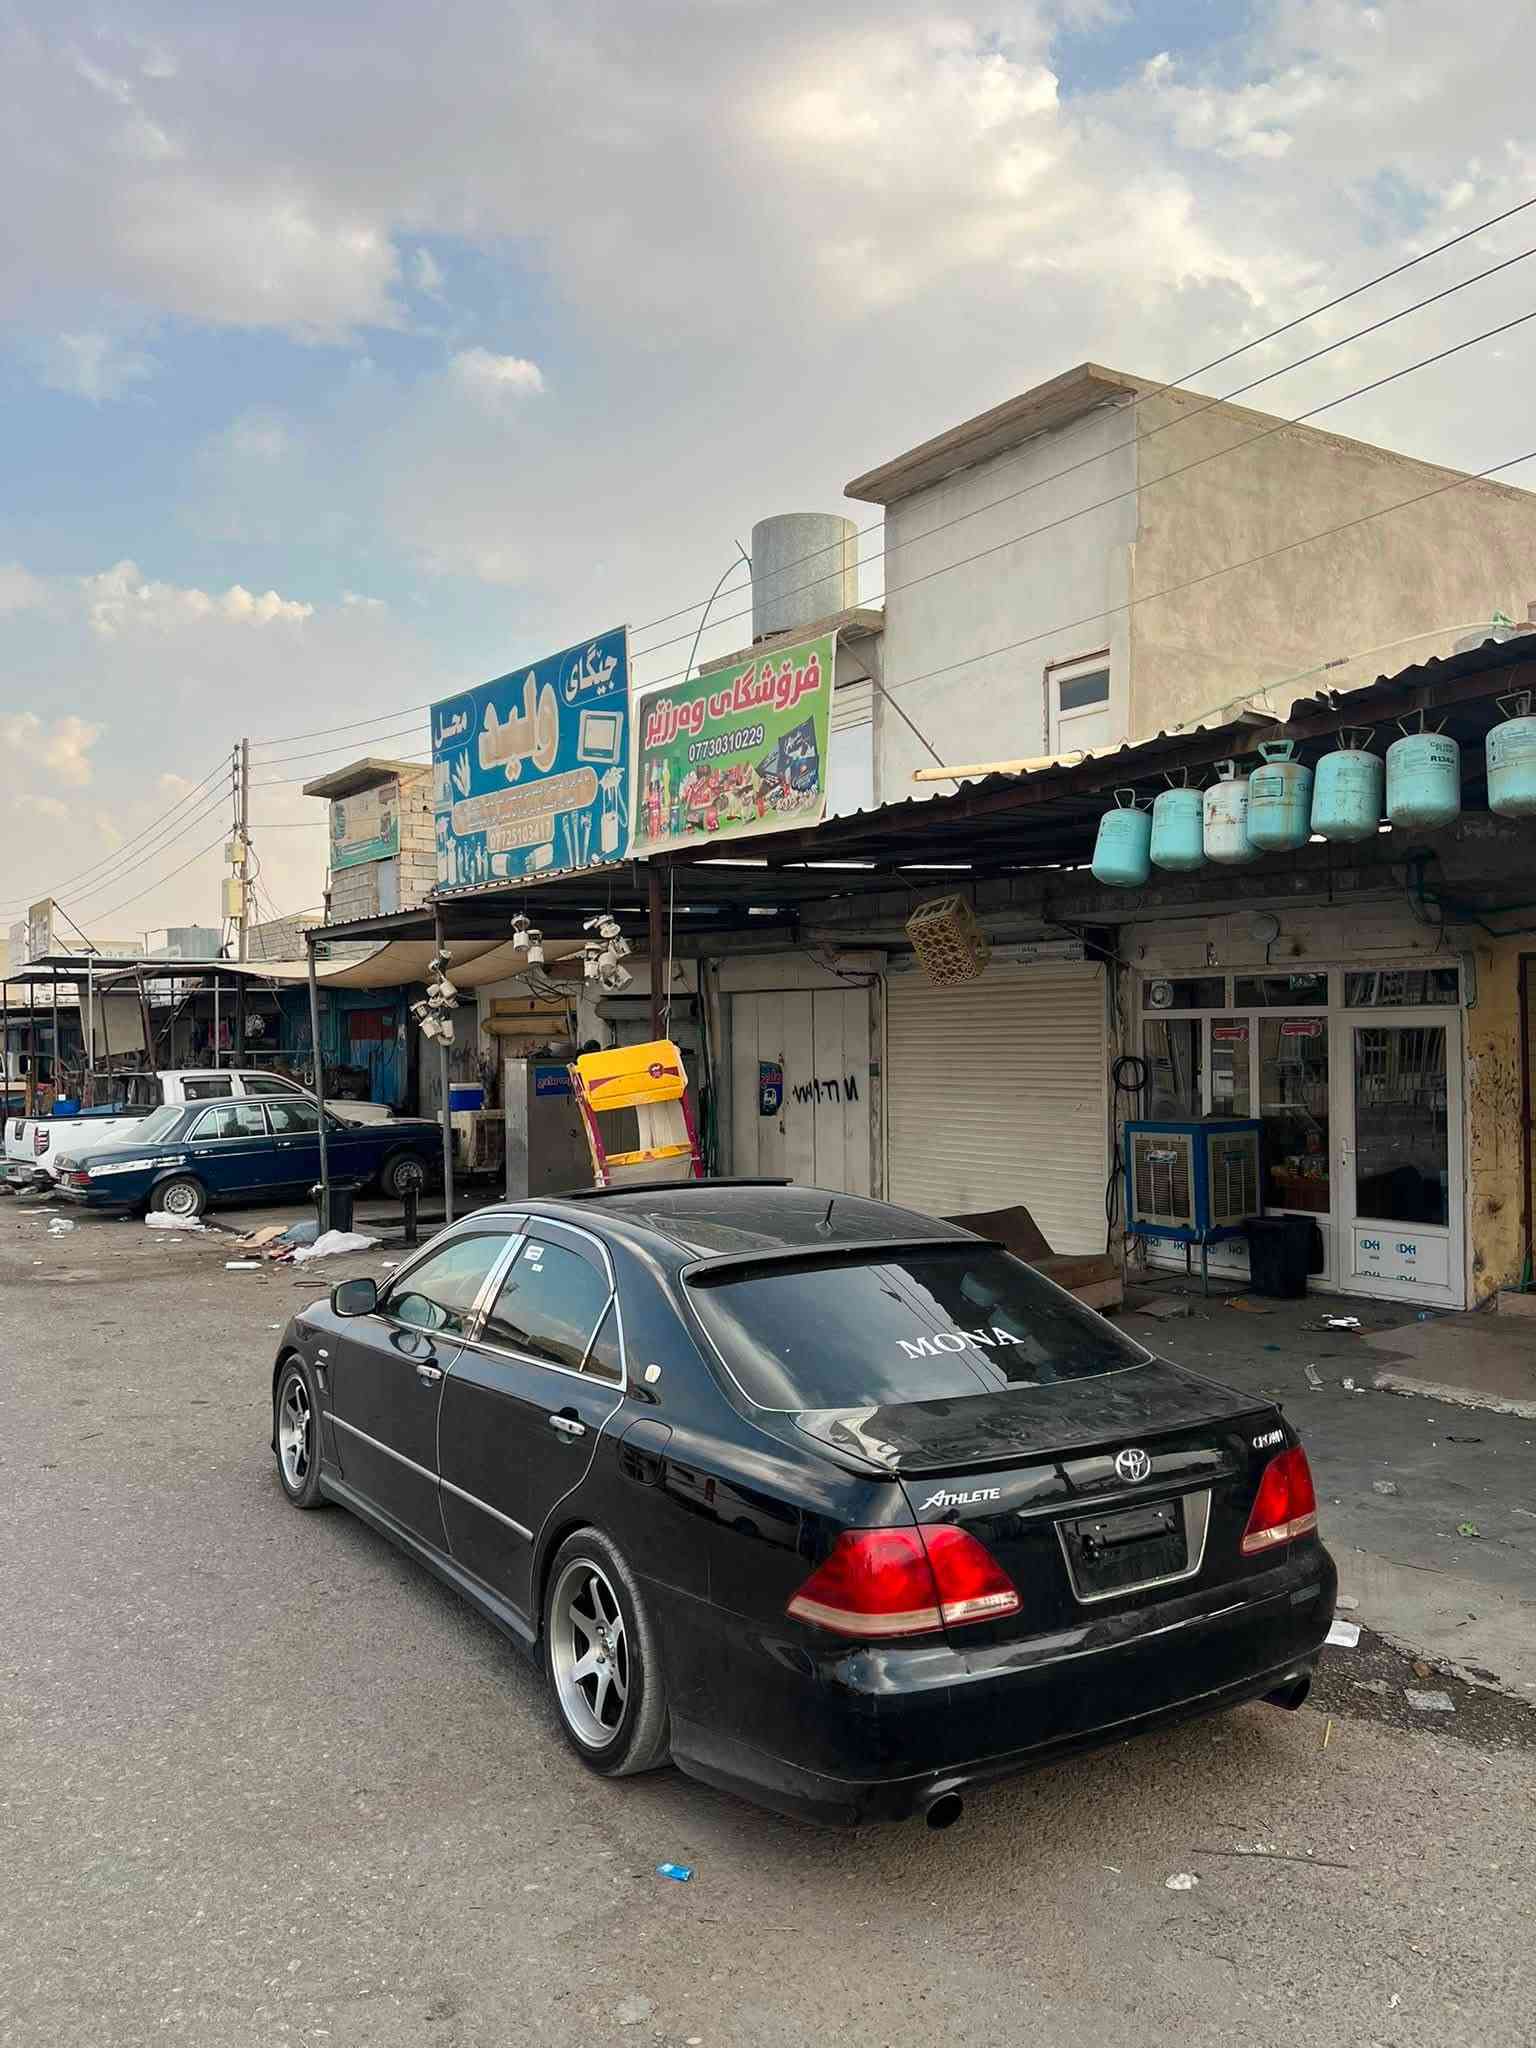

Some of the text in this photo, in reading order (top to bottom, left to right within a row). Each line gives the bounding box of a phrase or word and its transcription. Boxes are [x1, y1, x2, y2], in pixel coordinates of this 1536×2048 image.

[689, 725, 764, 761] 07730310229
[896, 1325, 1025, 1361] MONA
[919, 1487, 1002, 1511] ATHLETE
